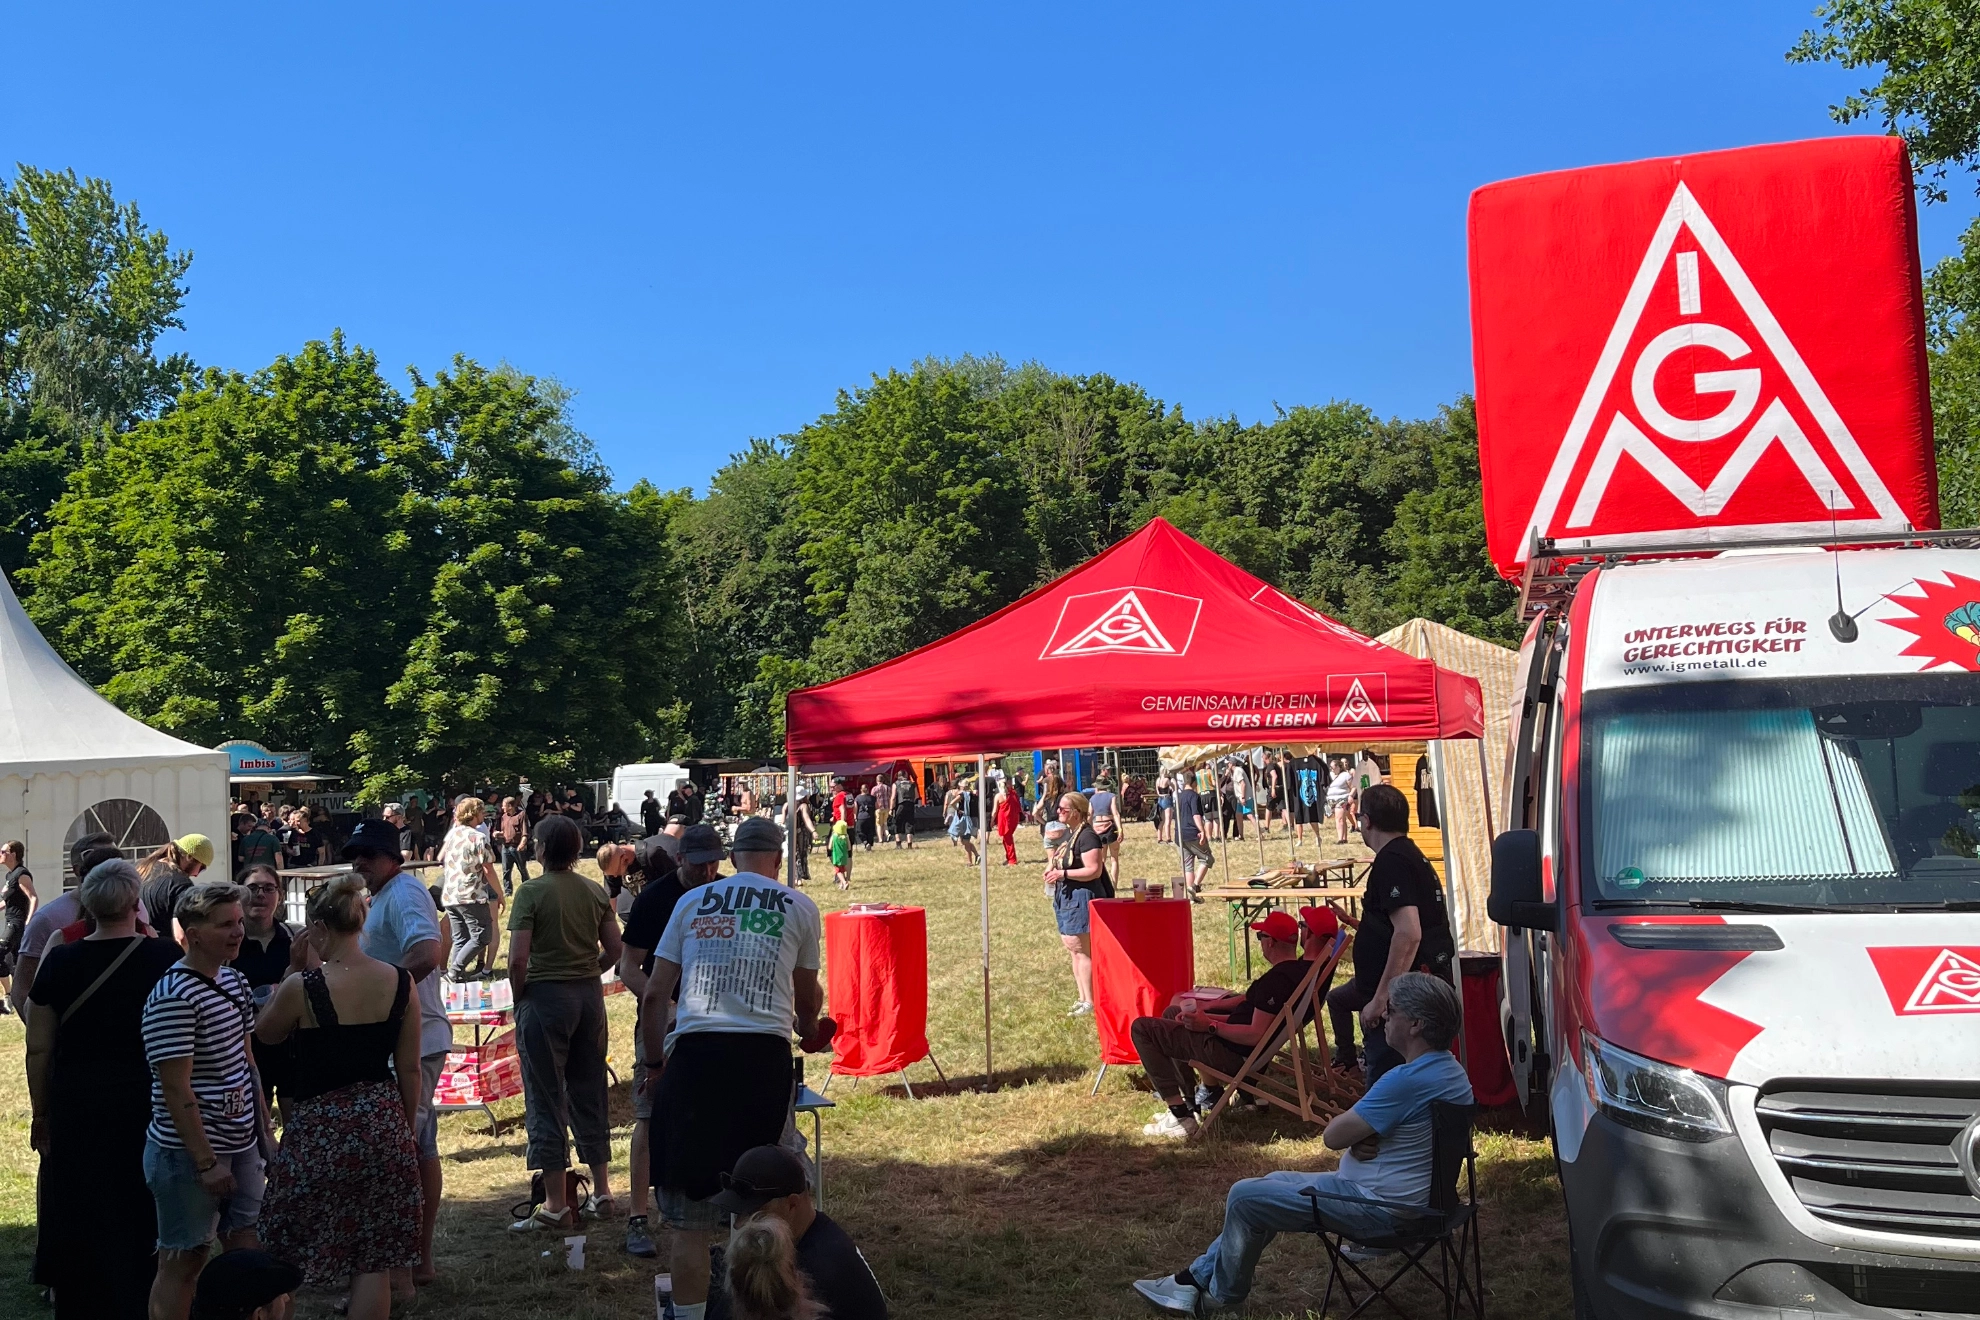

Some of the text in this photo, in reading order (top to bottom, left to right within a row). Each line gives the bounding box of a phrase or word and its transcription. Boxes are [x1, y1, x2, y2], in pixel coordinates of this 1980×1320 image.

[1624, 617, 1807, 644] UNTERWEGS FÜR
[1623, 638, 1806, 663] GERECHTIGKEIT
[1623, 658, 1767, 676] www.igmetall.de
[1141, 691, 1317, 711] GEMEINSAM FÜR EIN
[1207, 712, 1318, 729] GUTES LEBEN
[240, 758, 276, 769] Imbiss
[736, 908, 785, 938] 182
[696, 926, 735, 939] 2010
[224, 1091, 245, 1103] FCK
[222, 1101, 245, 1115] AFD
